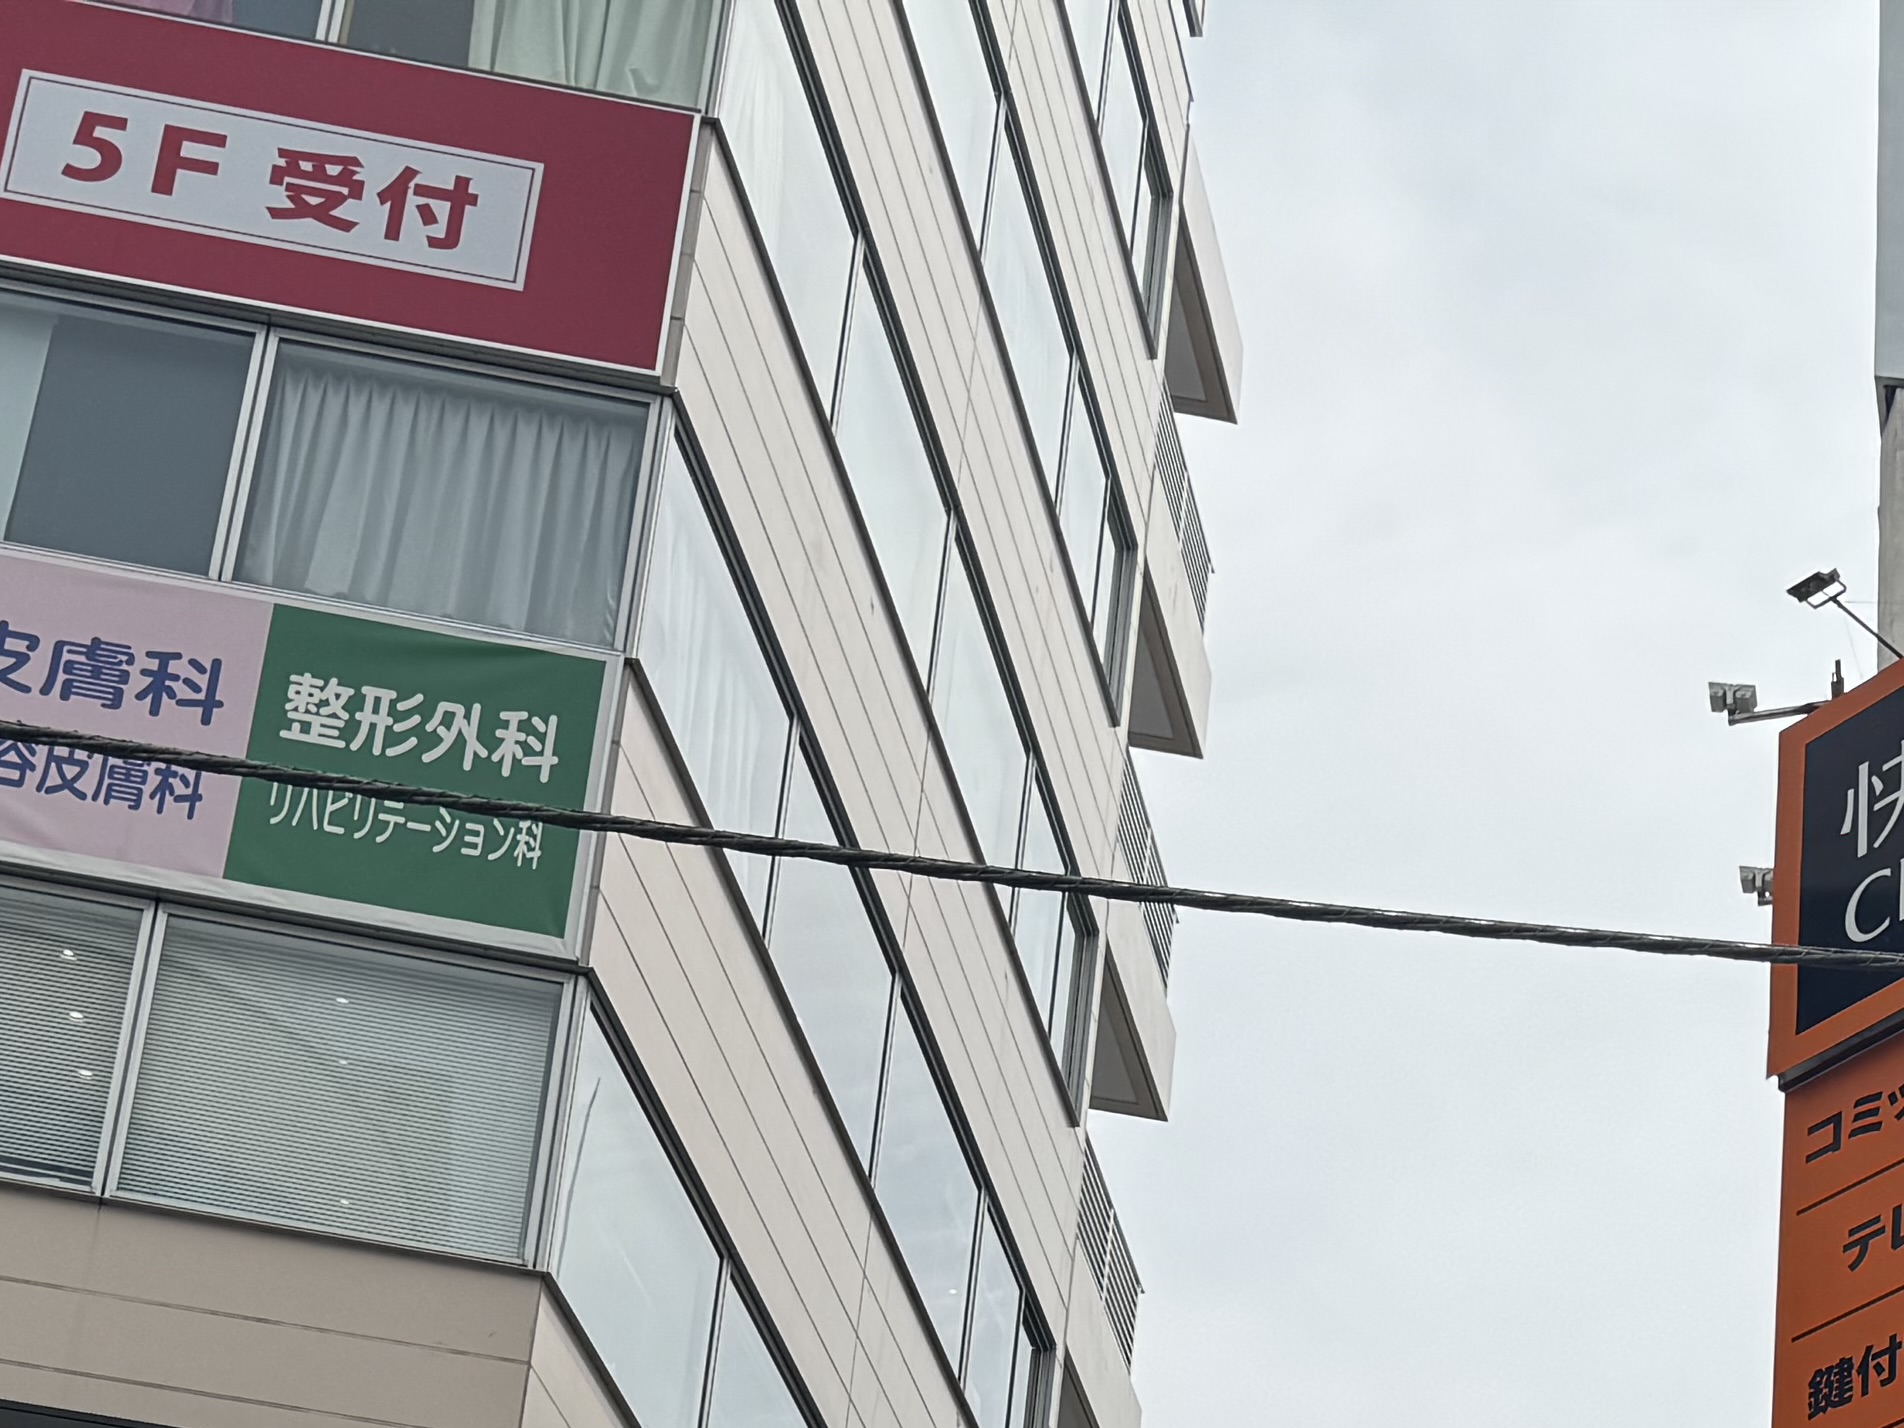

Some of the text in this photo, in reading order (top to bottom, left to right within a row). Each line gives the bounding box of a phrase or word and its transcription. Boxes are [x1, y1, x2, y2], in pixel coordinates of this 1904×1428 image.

[60, 111, 479, 251] 5F 受付
[279, 672, 560, 783] 整形外科
[267, 780, 544, 871] リハビリテーション科
